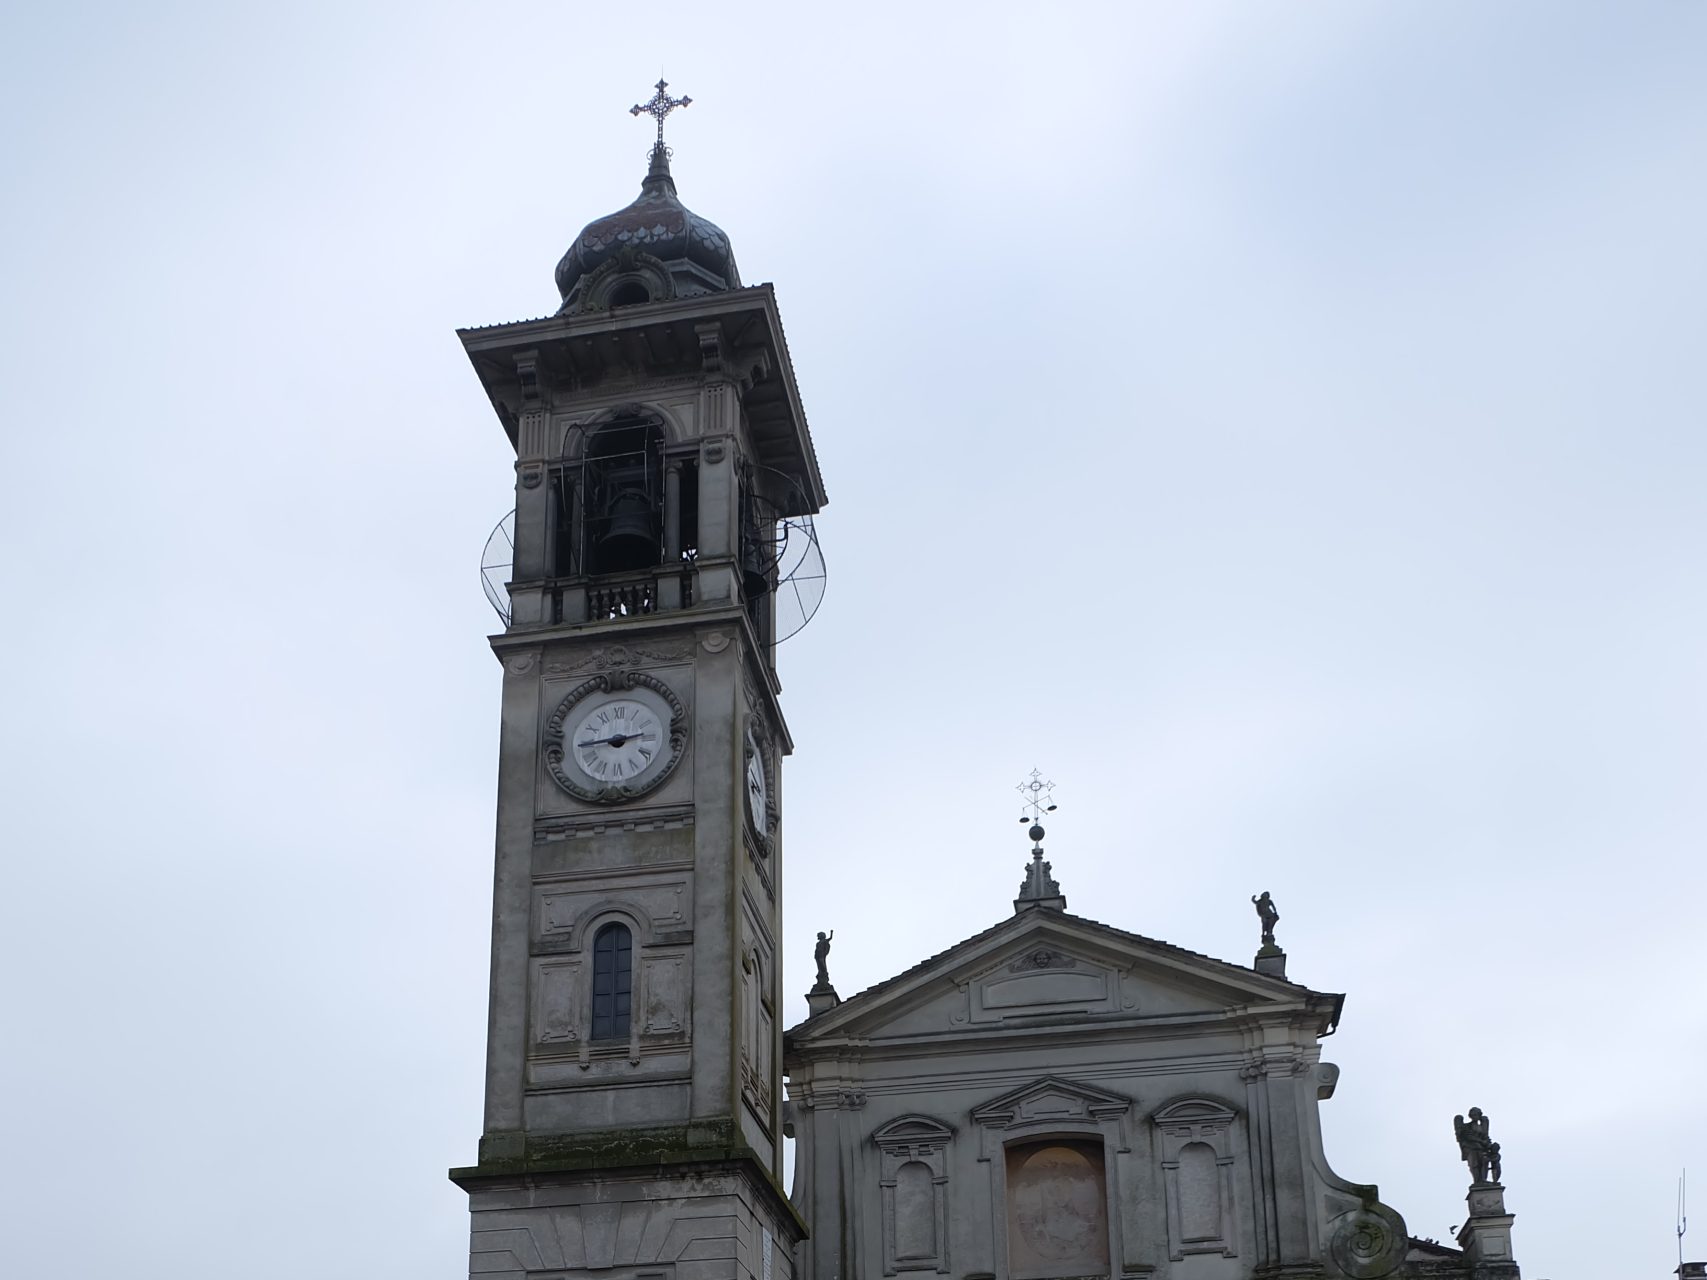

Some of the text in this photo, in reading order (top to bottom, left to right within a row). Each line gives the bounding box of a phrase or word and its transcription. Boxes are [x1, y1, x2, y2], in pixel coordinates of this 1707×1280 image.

[597, 712, 610, 725] XI
[614, 707, 625, 719] XII
[585, 724, 599, 734] X
